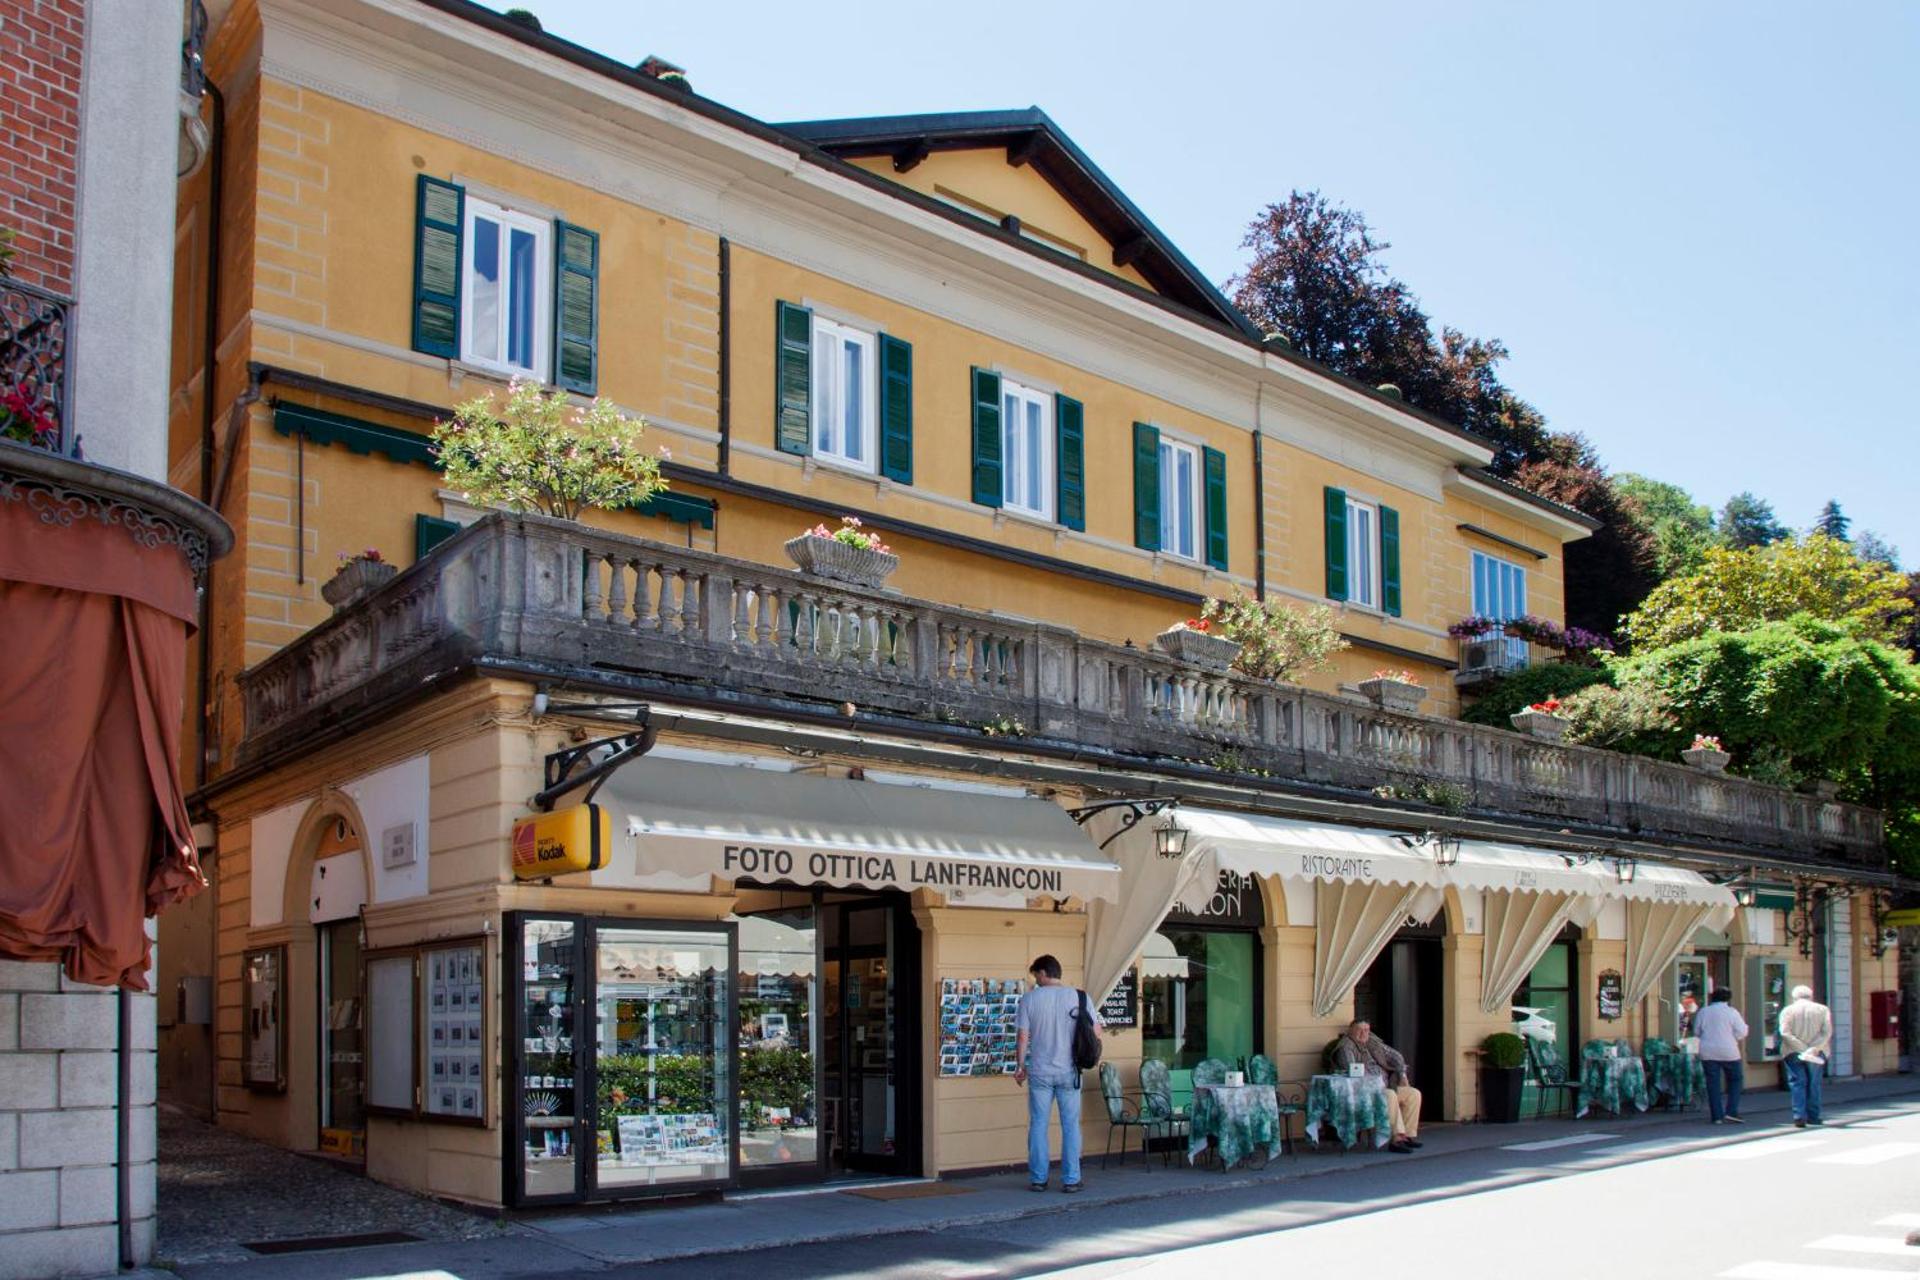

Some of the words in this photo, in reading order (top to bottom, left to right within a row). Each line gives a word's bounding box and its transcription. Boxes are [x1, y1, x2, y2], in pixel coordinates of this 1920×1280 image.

[537, 843, 567, 863] Kodak
[723, 845, 793, 875] FOTO
[808, 852, 897, 882] OTTICA
[910, 860, 1062, 892] LANFRANCONI
[1302, 855, 1372, 877] RISTORANTE
